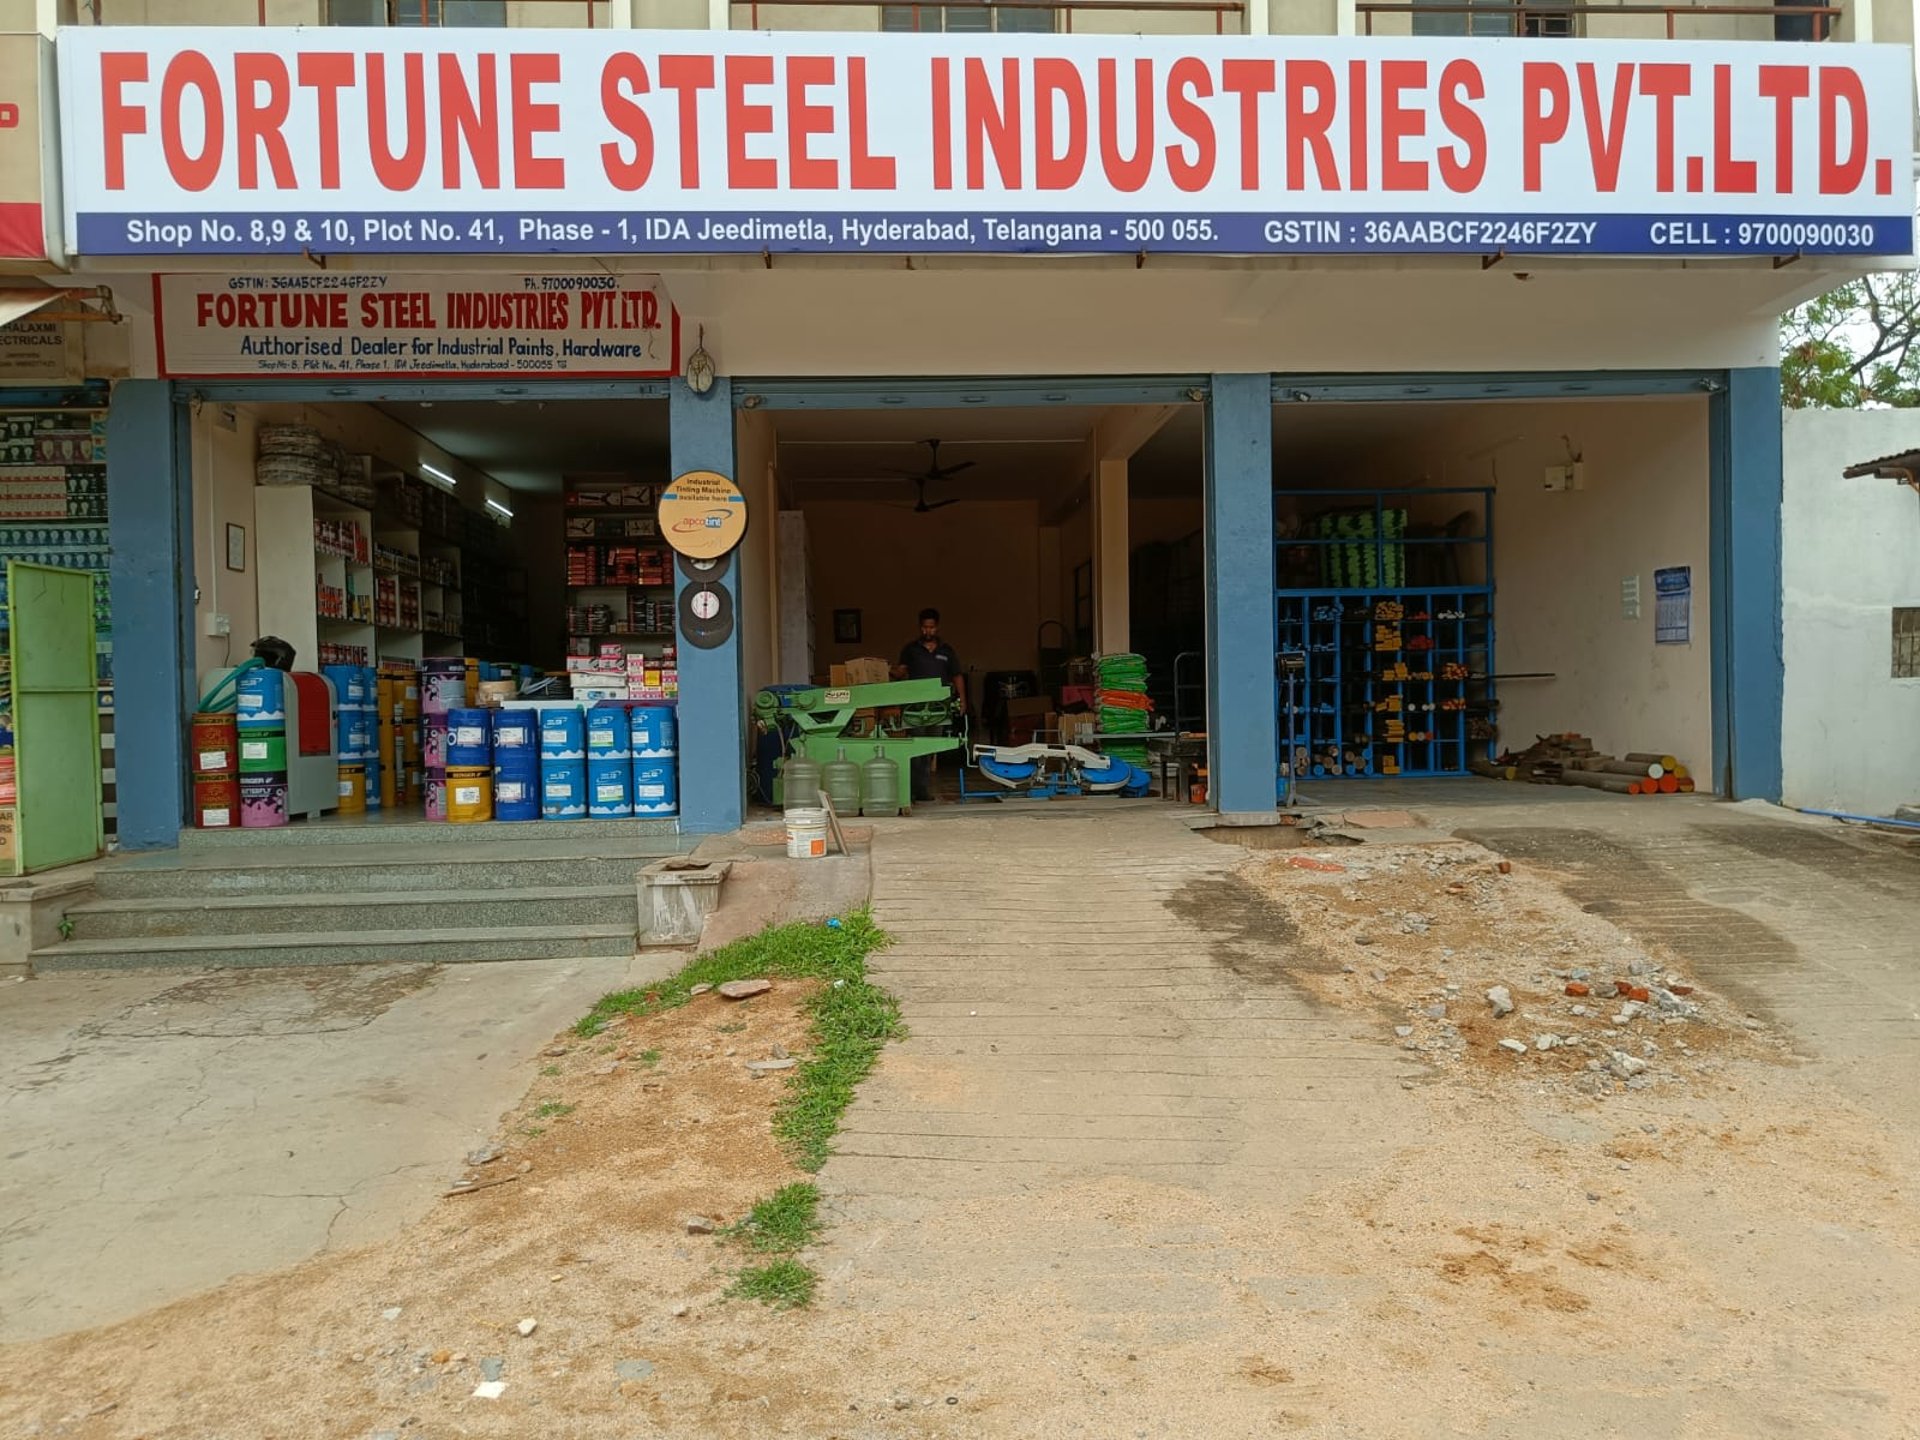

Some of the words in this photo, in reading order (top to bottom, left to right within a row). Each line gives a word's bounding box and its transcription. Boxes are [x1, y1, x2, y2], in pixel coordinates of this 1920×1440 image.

[101, 50, 565, 191] FORTUNE
[601, 52, 896, 191] STEEL
[931, 57, 1487, 193] INDUSTRIES
[127, 220, 193, 247] Shop
[201, 220, 242, 242] No.
[250, 219, 286, 245] 8,9
[294, 219, 313, 241] &
[320, 219, 355, 245] 10,
[364, 219, 413, 241] Plot
[420, 219, 461, 241] No.
[468, 219, 504, 245] 41,
[519, 218, 594, 240] Phase
[618, 218, 637, 244] 1,
[645, 218, 691, 240] IDA
[698, 218, 833, 244] Jeedimetla,
[842, 218, 975, 245] Hyderabad,
[983, 218, 1102, 246] Telangana
[1124, 218, 1165, 241] 500
[1171, 218, 1218, 241] 055.
[1264, 220, 1341, 243] GSTIN
[1364, 220, 1597, 244] 36AABCF2246F2ZY
[1650, 222, 1717, 244] CELL
[1738, 223, 1874, 246] 9700090030
[197, 292, 349, 329] FORTUNE
[360, 291, 437, 330] STEEL
[446, 291, 570, 330] INDUSTRIES
[240, 335, 343, 356] Authorised
[351, 336, 408, 355] Dealer
[412, 337, 434, 354] for
[437, 337, 504, 355] Industrial
[508, 337, 559, 357] Paints,
[562, 338, 642, 357] Hardware
